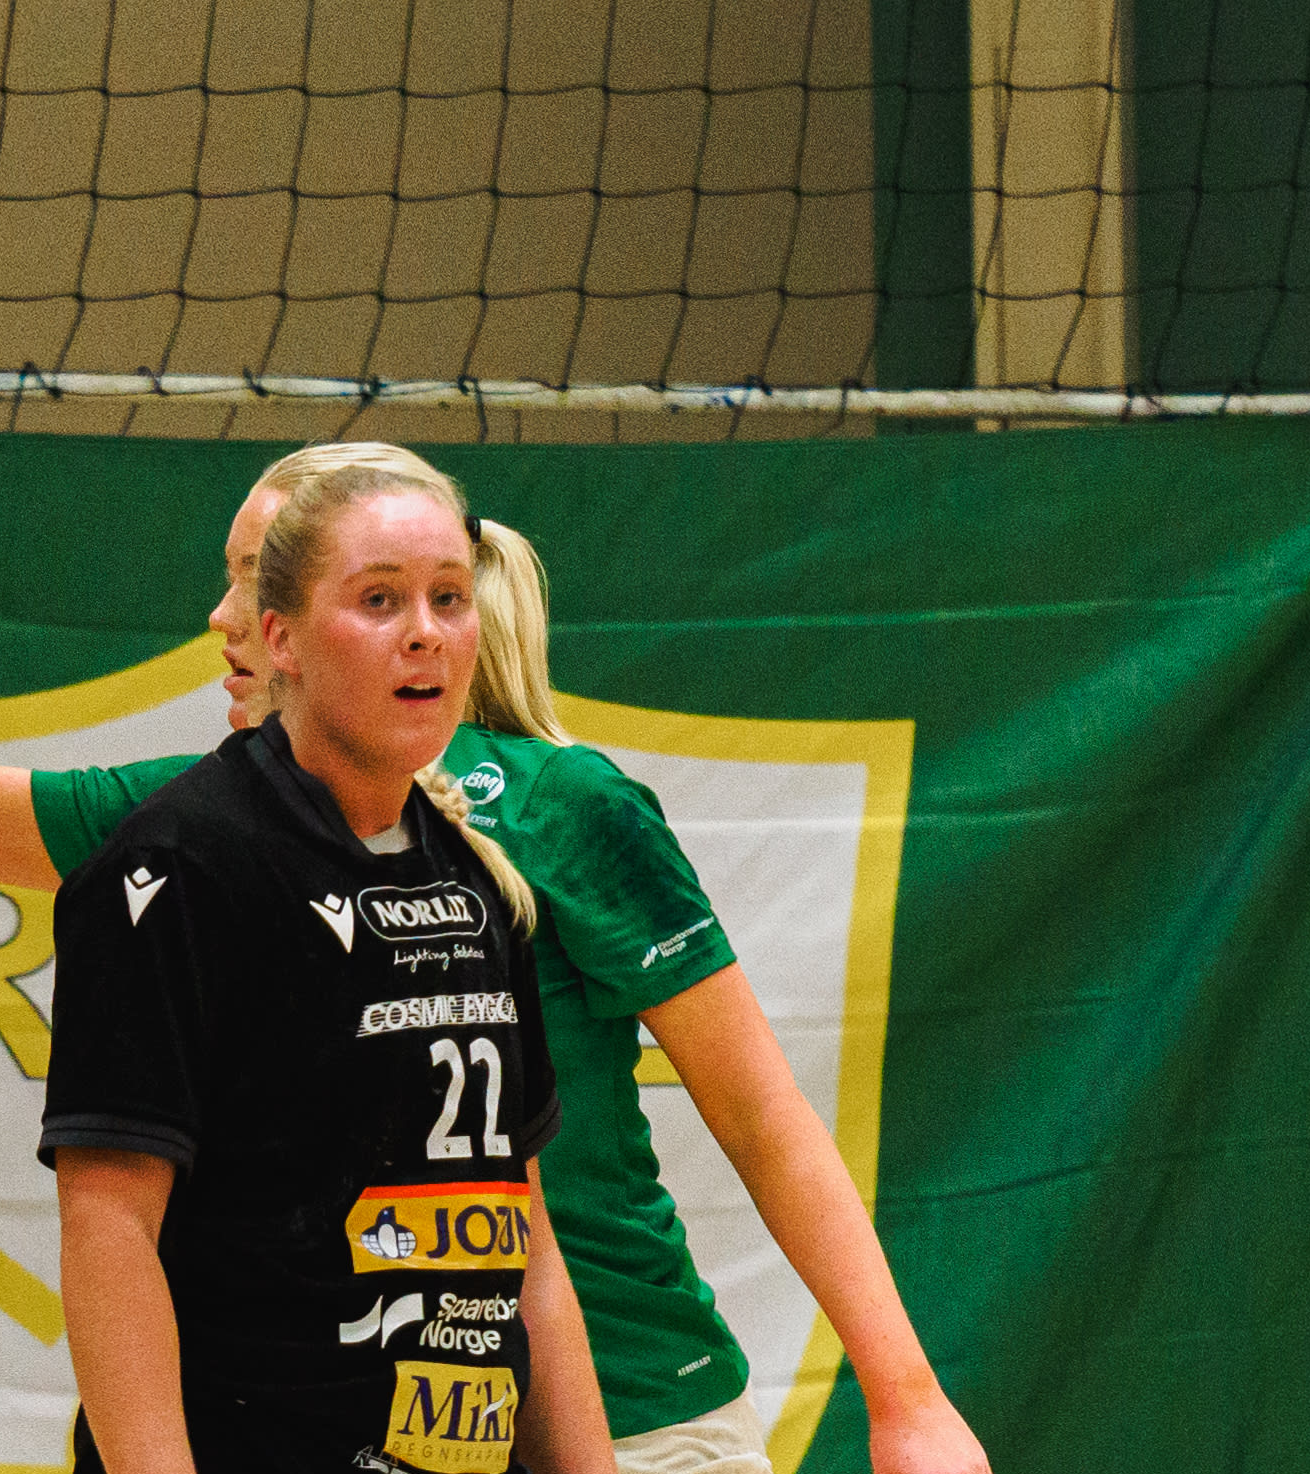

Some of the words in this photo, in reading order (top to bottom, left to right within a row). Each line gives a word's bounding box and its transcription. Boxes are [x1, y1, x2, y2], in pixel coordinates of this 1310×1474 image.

[394, 948, 450, 973] Lighting
[427, 1037, 512, 1160] 22
[419, 1320, 501, 1355] Norge
